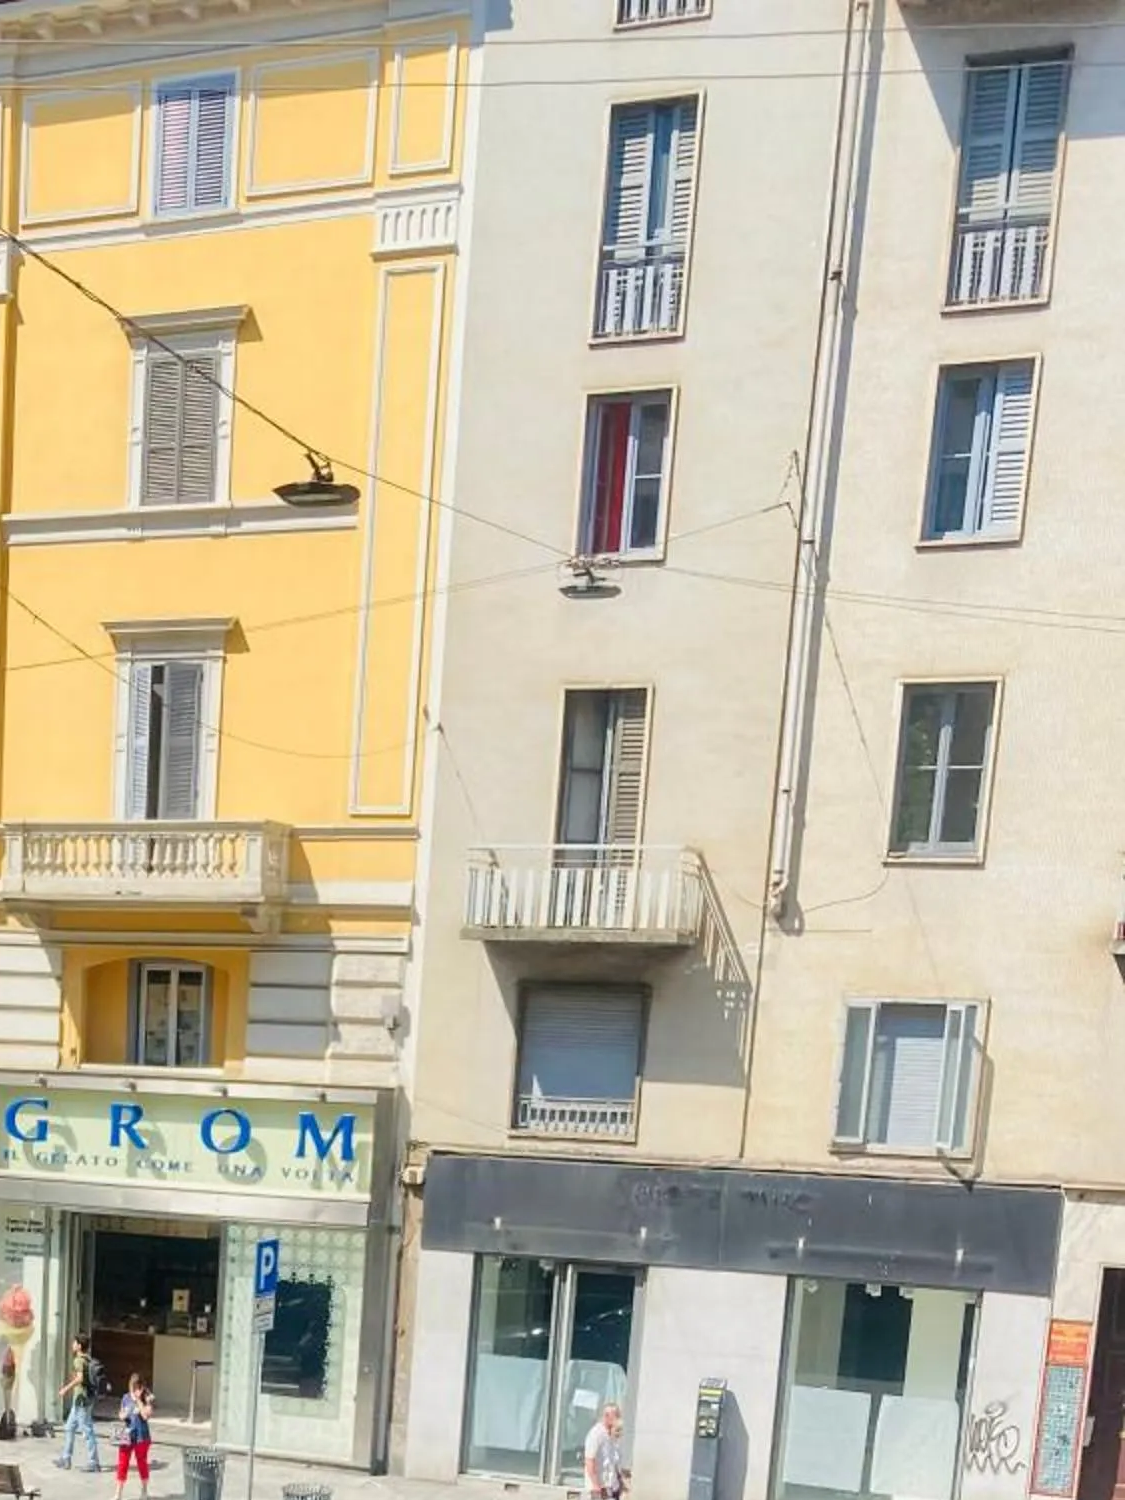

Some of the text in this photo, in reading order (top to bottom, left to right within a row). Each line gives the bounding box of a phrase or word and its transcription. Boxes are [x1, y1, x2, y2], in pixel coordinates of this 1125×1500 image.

[4, 1097, 357, 1162] GROM
[3, 1148, 355, 1183] IL GELATO COME UNA VOLTA
[259, 1246, 276, 1291] P
